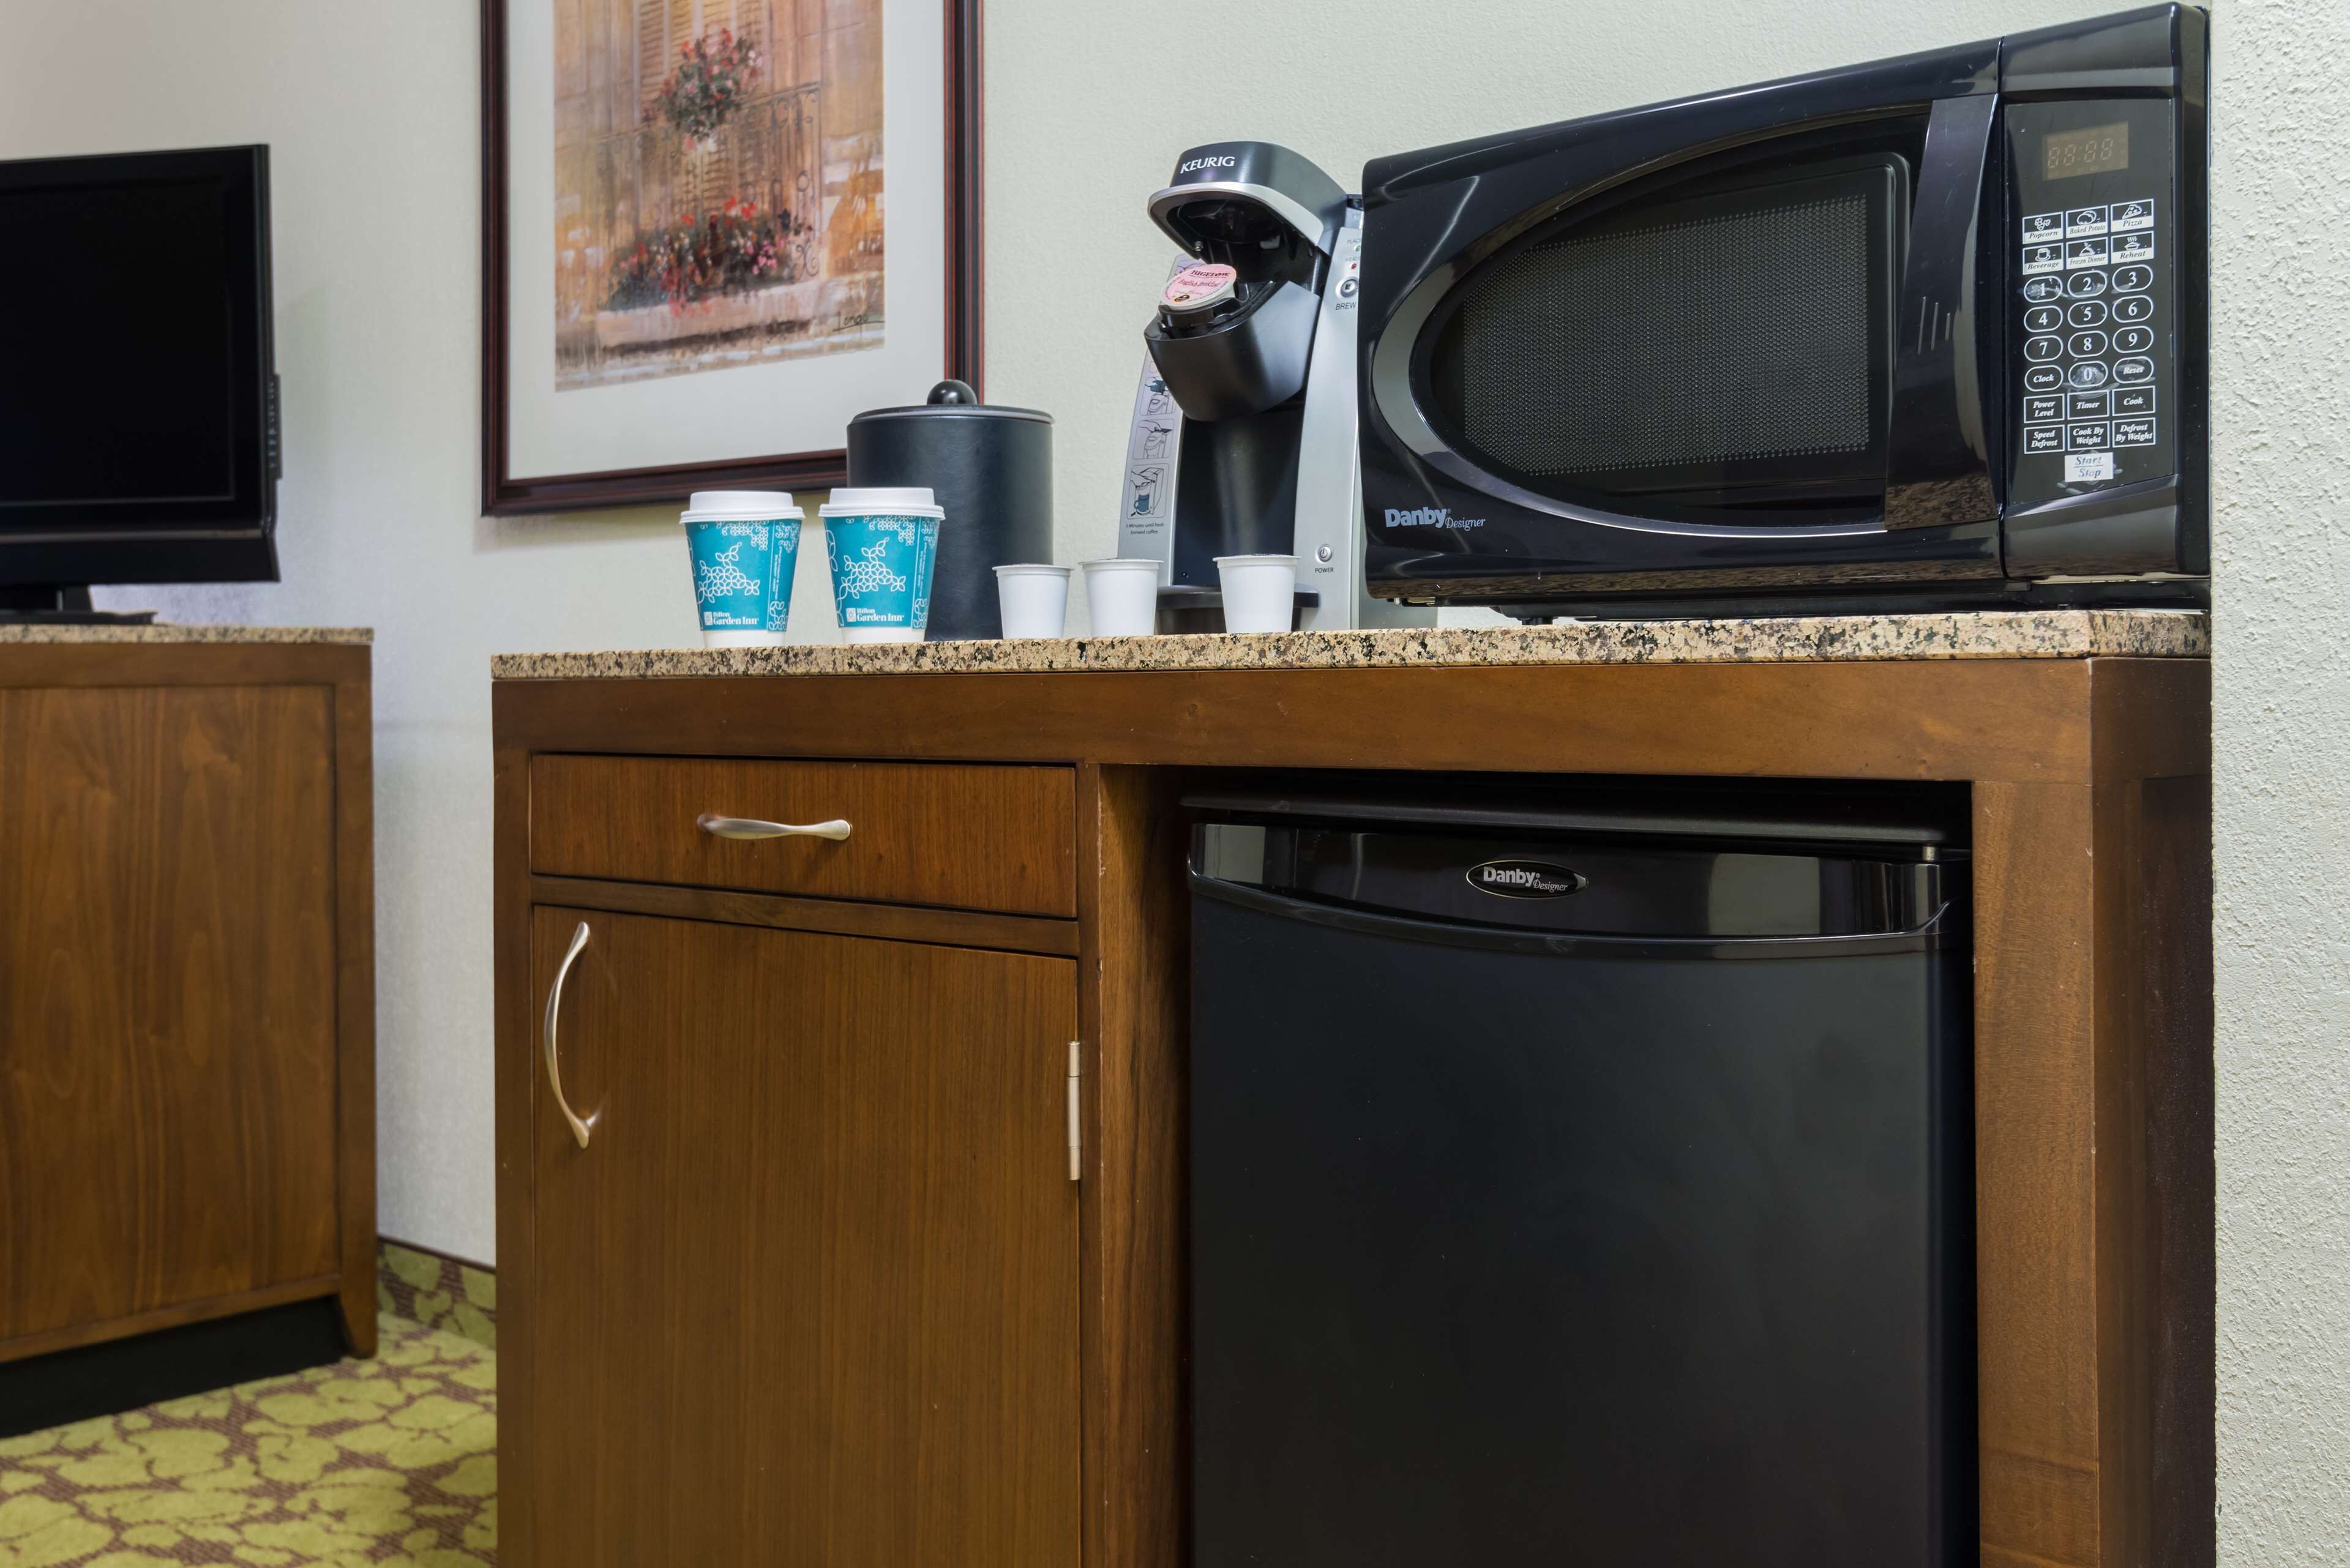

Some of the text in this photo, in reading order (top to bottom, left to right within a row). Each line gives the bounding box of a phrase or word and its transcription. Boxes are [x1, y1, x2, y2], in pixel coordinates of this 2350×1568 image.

[1180, 156, 1235, 174] KEURIG
[2029, 231, 2057, 239] Popcorn
[2070, 226, 2087, 234] Baked
[2120, 250, 2146, 259] Reheat
[2027, 261, 2060, 270] Beverage
[2128, 271, 2137, 286] 3
[2082, 277, 2092, 291] 2
[2040, 283, 2046, 296] 1
[1336, 302, 1356, 310] BREW
[2128, 301, 2138, 316] 6
[2038, 312, 2048, 326] 4
[2083, 307, 2092, 321] 5
[2083, 337, 2092, 351] 8
[2128, 332, 2138, 347] 9
[2039, 342, 2048, 356] 7
[2083, 367, 2092, 381] 0
[2123, 366, 2144, 375] Reset
[2033, 374, 2054, 383] Clock
[2076, 401, 2100, 409] Timer
[2123, 397, 2144, 406] Cook
[2034, 409, 2054, 417] Level
[2073, 427, 2105, 436] Cook By
[2120, 424, 2148, 433] Defrost
[2033, 430, 2056, 440] Speed
[2116, 431, 2153, 443] By Weight
[2031, 439, 2058, 449] Defrost
[2076, 436, 2101, 446] Weight
[2076, 456, 2101, 466] Start
[2078, 468, 2101, 479] Stop
[1385, 507, 1486, 531] Danby Designer
[713, 616, 758, 625] Garden Inn
[857, 613, 903, 622] Garden Inn
[1483, 866, 1568, 892] Danby Designer
